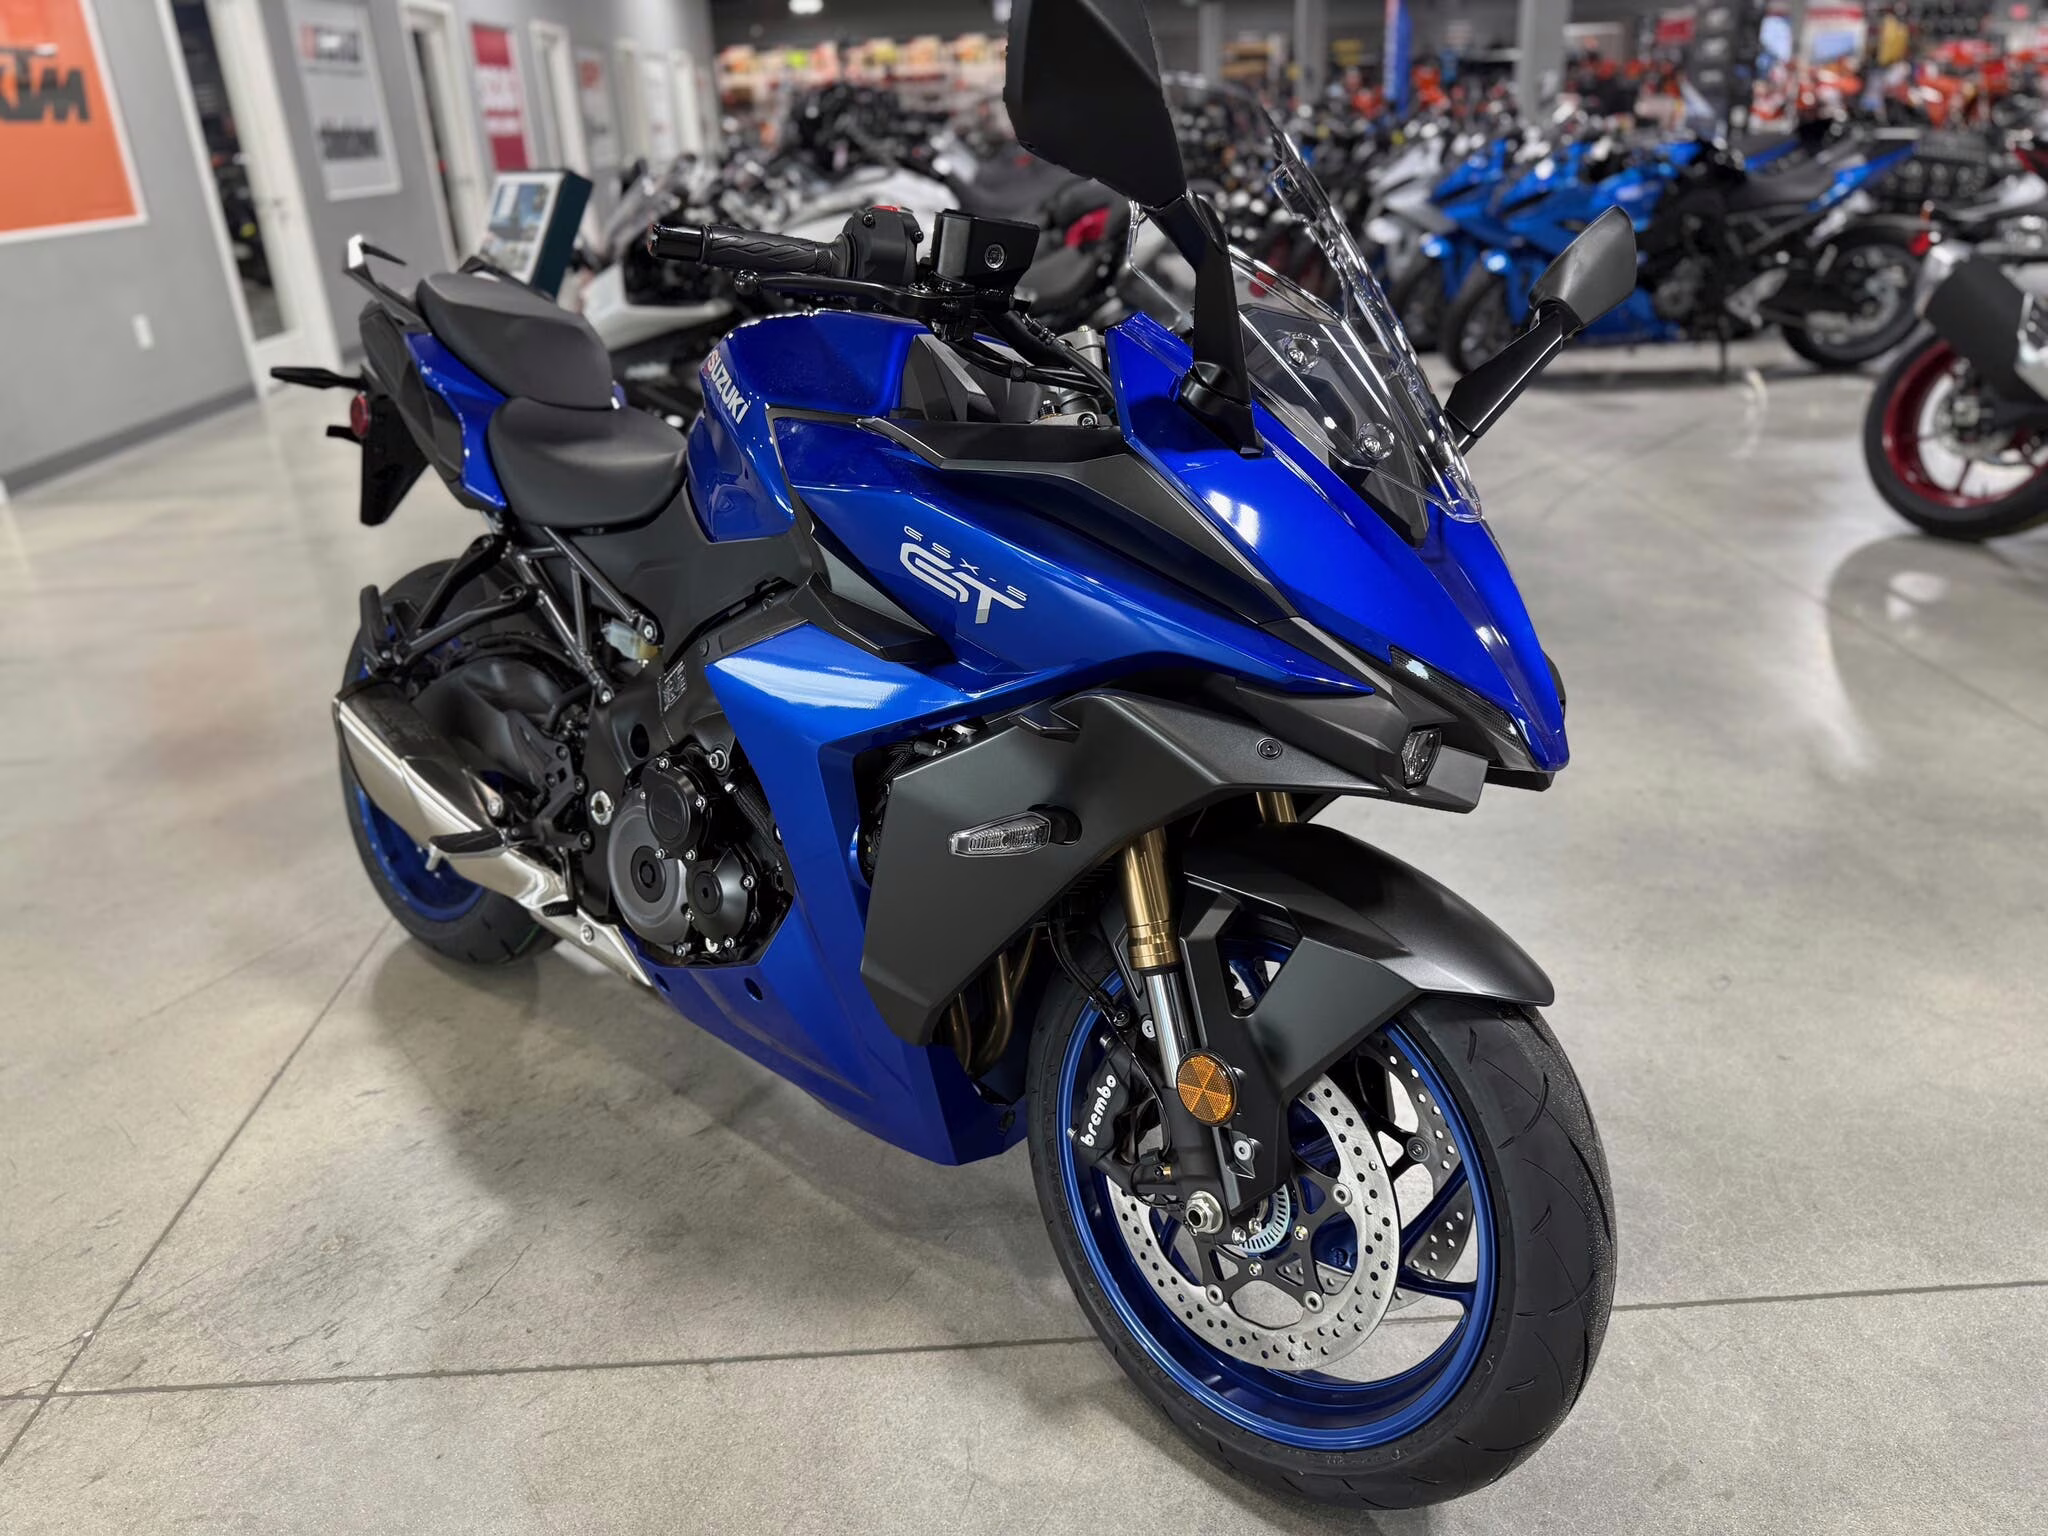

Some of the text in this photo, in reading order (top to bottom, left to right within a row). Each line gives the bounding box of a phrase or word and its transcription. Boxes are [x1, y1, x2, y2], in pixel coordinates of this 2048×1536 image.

[707, 349, 749, 425] SUZUKI
[904, 525, 1027, 601] GSX-S
[1080, 1074, 1117, 1147] brembo
